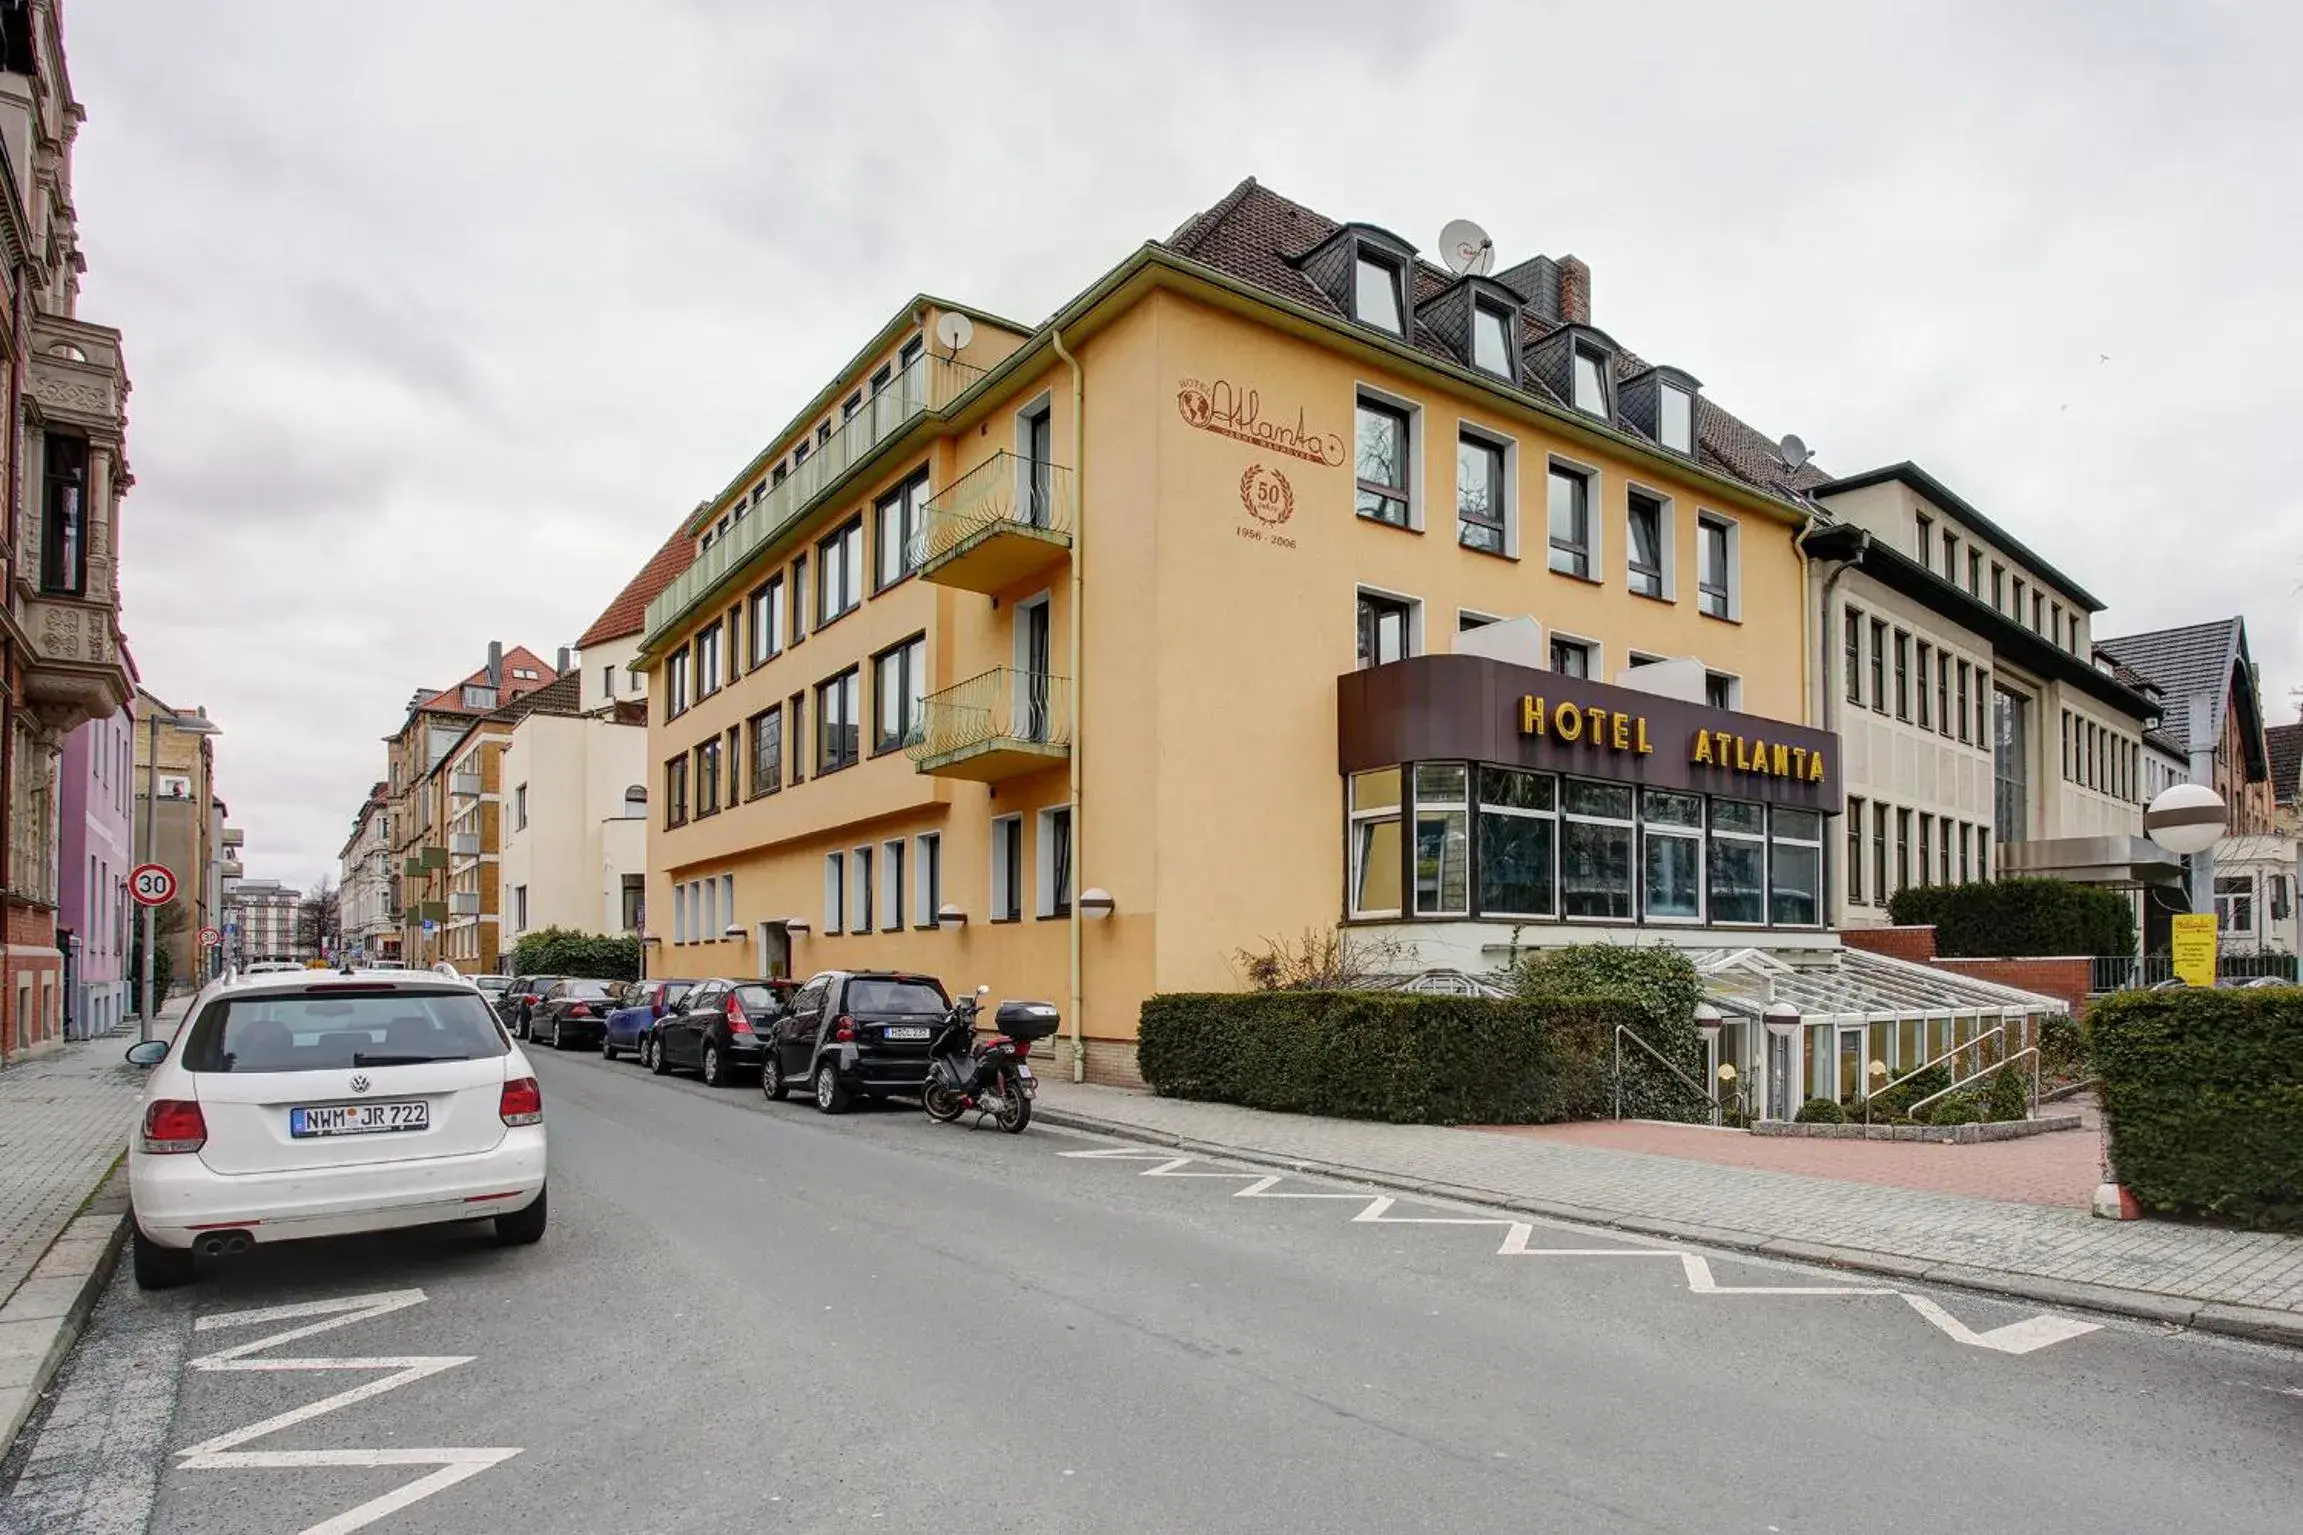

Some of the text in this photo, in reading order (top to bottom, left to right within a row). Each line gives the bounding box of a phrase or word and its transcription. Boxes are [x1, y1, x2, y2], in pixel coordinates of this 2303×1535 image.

[1211, 380, 1338, 461] Atlanta
[1259, 481, 1280, 504] 50
[1236, 525, 1262, 541] 1956
[1271, 535, 1297, 549] 2006
[1519, 693, 1825, 784] HOTEL ATLANTA
[139, 875, 167, 894] 30
[203, 933, 216, 942] 30
[306, 1105, 425, 1130] NWM JR 722
